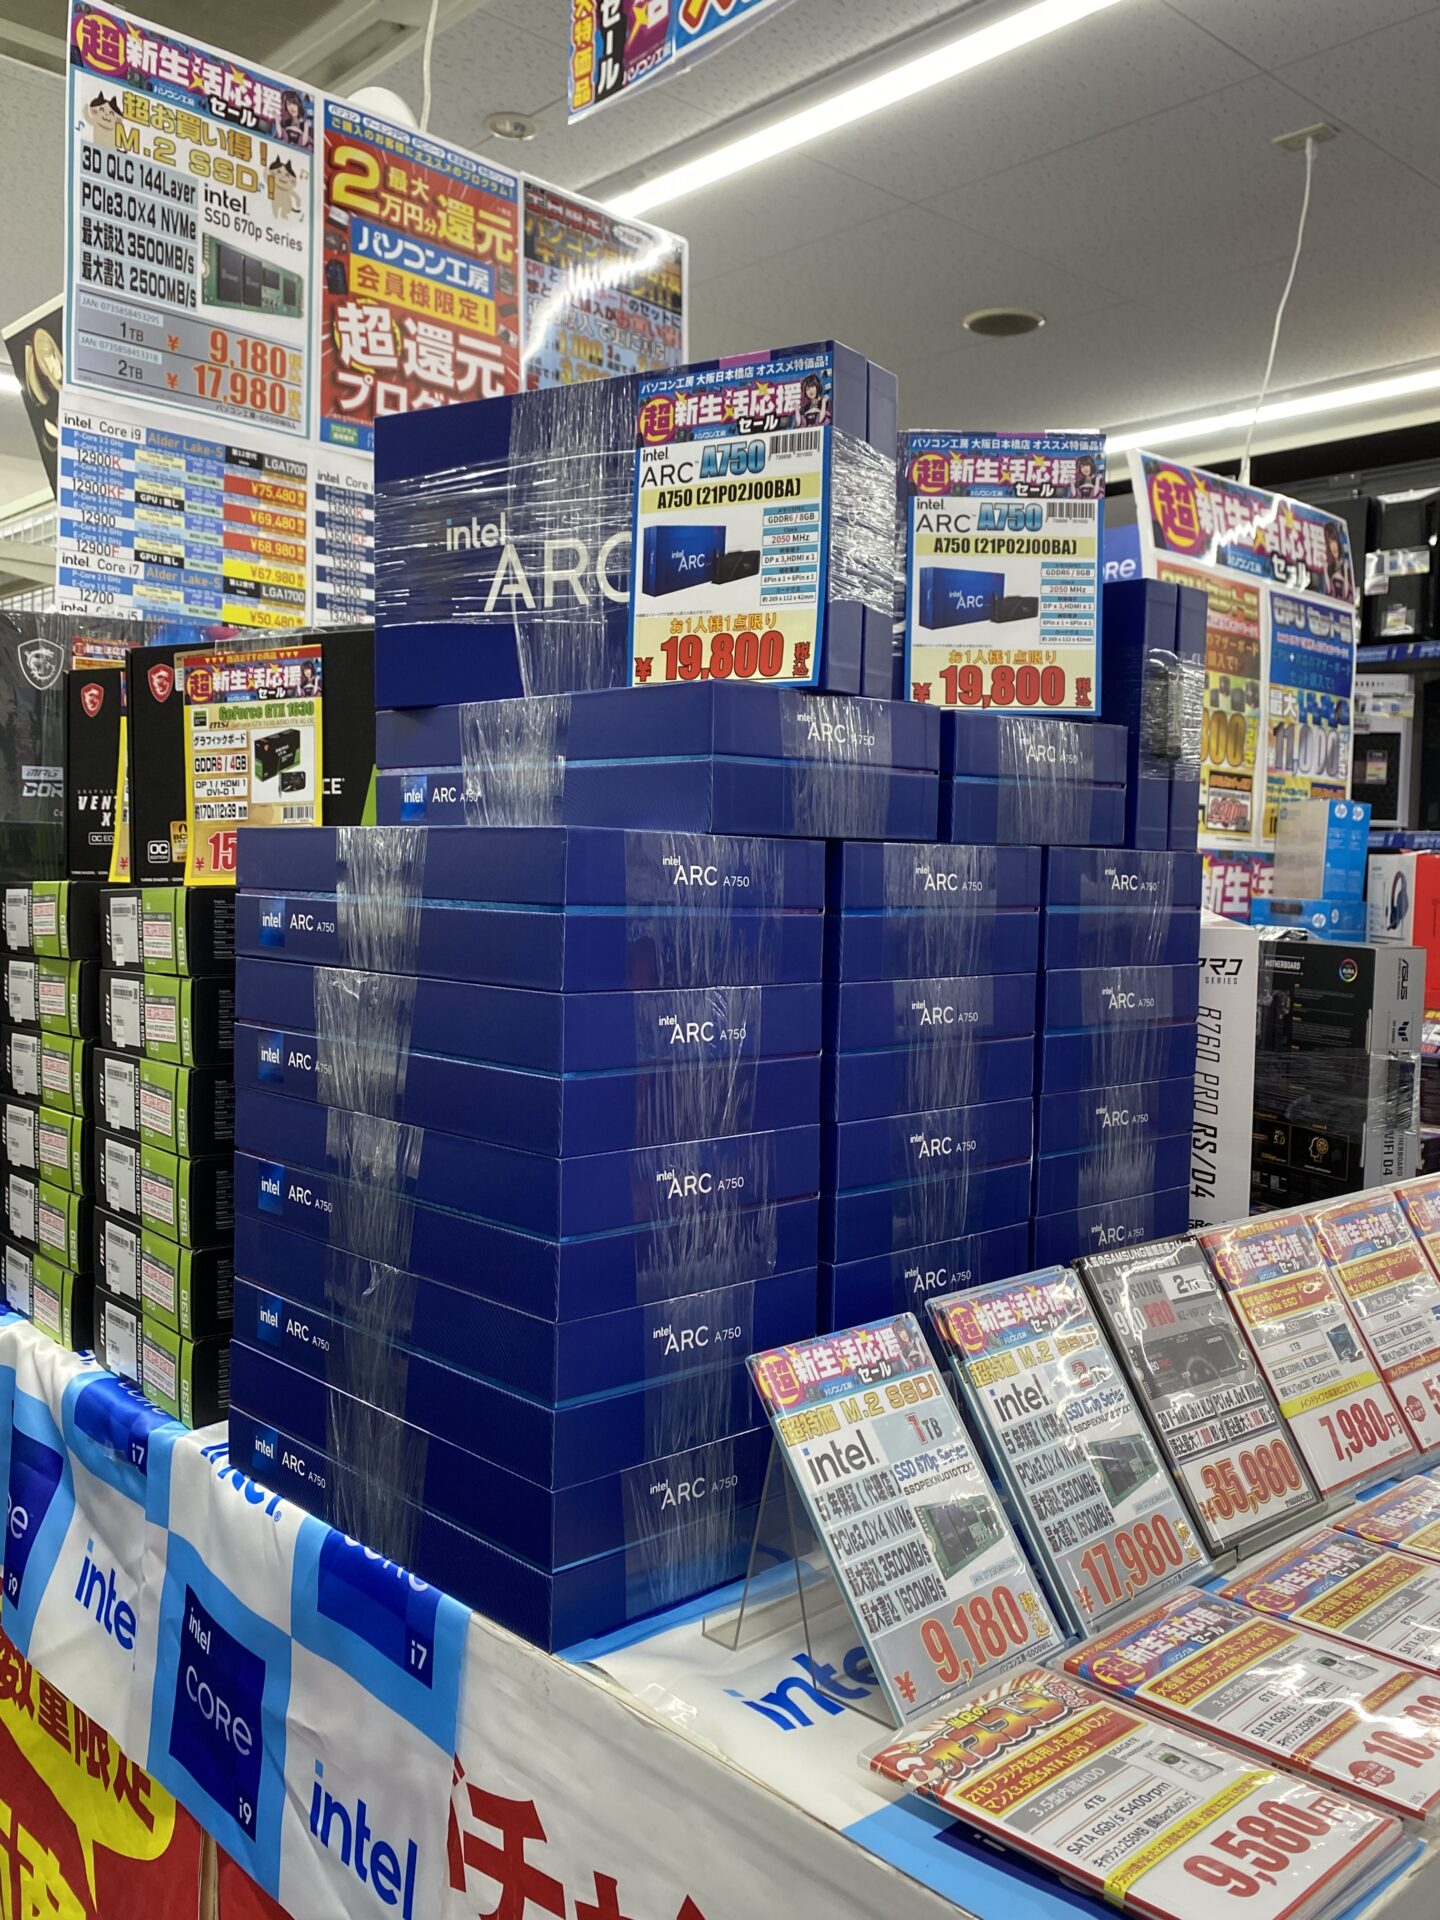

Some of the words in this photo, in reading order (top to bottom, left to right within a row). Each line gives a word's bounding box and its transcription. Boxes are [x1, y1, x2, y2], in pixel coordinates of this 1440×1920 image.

[210, 96, 258, 128] セール
[115, 122, 177, 167] M.2
[82, 145, 101, 174] 3D
[106, 152, 135, 185] QLC
[140, 164, 197, 205] 144Layer
[388, 166, 430, 201] 最大
[203, 185, 249, 216] intel
[161, 204, 197, 240] NVMe
[204, 207, 231, 229] SSD
[234, 216, 263, 242] 670p
[265, 227, 304, 252] Series
[437, 195, 514, 265] 還元
[128, 233, 195, 275] 3500MB/s
[357, 224, 491, 294] パソコン工房
[130, 265, 197, 308] 2500MB/s
[209, 330, 288, 380] 9,180
[192, 363, 287, 414] 17,980
[641, 376, 693, 394] パソコン工房
[696, 366, 754, 386] 大阪日本橋店
[64, 413, 92, 430] intel
[99, 421, 127, 438] Core
[130, 425, 142, 441] i9
[739, 414, 779, 435] セール
[76, 448, 122, 470] 12900K
[642, 447, 668, 463] intel
[912, 439, 969, 451] パソコン工房
[971, 439, 1031, 451] 大阪日本橋店
[264, 456, 307, 478] LGA1700
[641, 462, 694, 489] ARC
[699, 439, 766, 479] A750
[71, 477, 126, 500] 12900KF
[657, 489, 693, 510] A750
[1015, 482, 1055, 497] セール
[81, 509, 116, 527] 12900
[767, 514, 794, 525] GDDR6
[799, 512, 815, 524] 8GB
[916, 498, 946, 511] intel
[916, 514, 971, 534] ARC
[977, 502, 1043, 532] A750
[446, 511, 506, 551] intel
[772, 534, 792, 544] 2050
[792, 533, 810, 543] MHz
[933, 537, 970, 554] A750
[62, 553, 91, 569] intel
[97, 558, 126, 575] Core
[129, 562, 140, 578] i7
[669, 612, 777, 635] お1人様1点限り
[634, 657, 654, 683] ¥
[660, 630, 785, 682] 19,800
[792, 641, 810, 677] 税込
[912, 682, 932, 705] ¥
[939, 665, 1066, 709] 19,800
[807, 722, 846, 744] ARC
[194, 757, 222, 773] GDDR6
[230, 755, 247, 771] 4GB
[404, 788, 424, 804] intel
[432, 786, 457, 803] ARC
[662, 855, 681, 867] intel
[673, 865, 718, 887] ARC
[722, 875, 750, 888] A750
[924, 873, 958, 892] ARC
[961, 880, 983, 892] A750
[1111, 875, 1138, 891] ARC
[262, 911, 282, 930] intel
[289, 913, 314, 932] ARC
[316, 920, 335, 934] A750
[1264, 959, 1301, 971] MOTHERBOARD
[1204, 976, 1239, 985] SERIES
[1400, 958, 1409, 1001] ASUS
[658, 1014, 678, 1027] intel
[919, 1005, 954, 1026] ARC
[957, 1010, 979, 1024] A750
[670, 1021, 715, 1045] ARC
[719, 1027, 748, 1041] A750
[261, 1046, 280, 1065] intel
[287, 1050, 312, 1072] ARC
[1193, 1072, 1220, 1116] PRO
[918, 1136, 952, 1159] ARC
[955, 1139, 977, 1153] A750
[1190, 1123, 1218, 1199] RS/D4
[261, 1176, 280, 1197] intel
[287, 1185, 312, 1207] ARC
[668, 1172, 712, 1200] ARC
[717, 1176, 745, 1192] A750
[664, 1325, 709, 1356] ARC
[714, 1325, 742, 1343] A750
[858, 1362, 892, 1384] セール
[840, 1391, 885, 1424] M.2
[989, 1373, 1050, 1423] intel
[131, 1442, 145, 1466] i7
[802, 1429, 876, 1486] intel
[1200, 1438, 1303, 1515] 35,980
[661, 1477, 706, 1511] ARC
[886, 1507, 917, 1535] NVMe
[1080, 1513, 1185, 1607] 17,980
[189, 1606, 212, 1655] intel
[920, 1585, 1030, 1686] 9,180
[409, 1639, 428, 1672] i7
[238, 1796, 252, 1825] i9
[1083, 1794, 1107, 1813] 4TB
[1067, 1832, 1098, 1857] SATA
[1091, 1813, 1127, 1844] 6Gb/s
[1119, 1780, 1173, 1817] 5400rpm
[310, 1759, 418, 1920] intel
